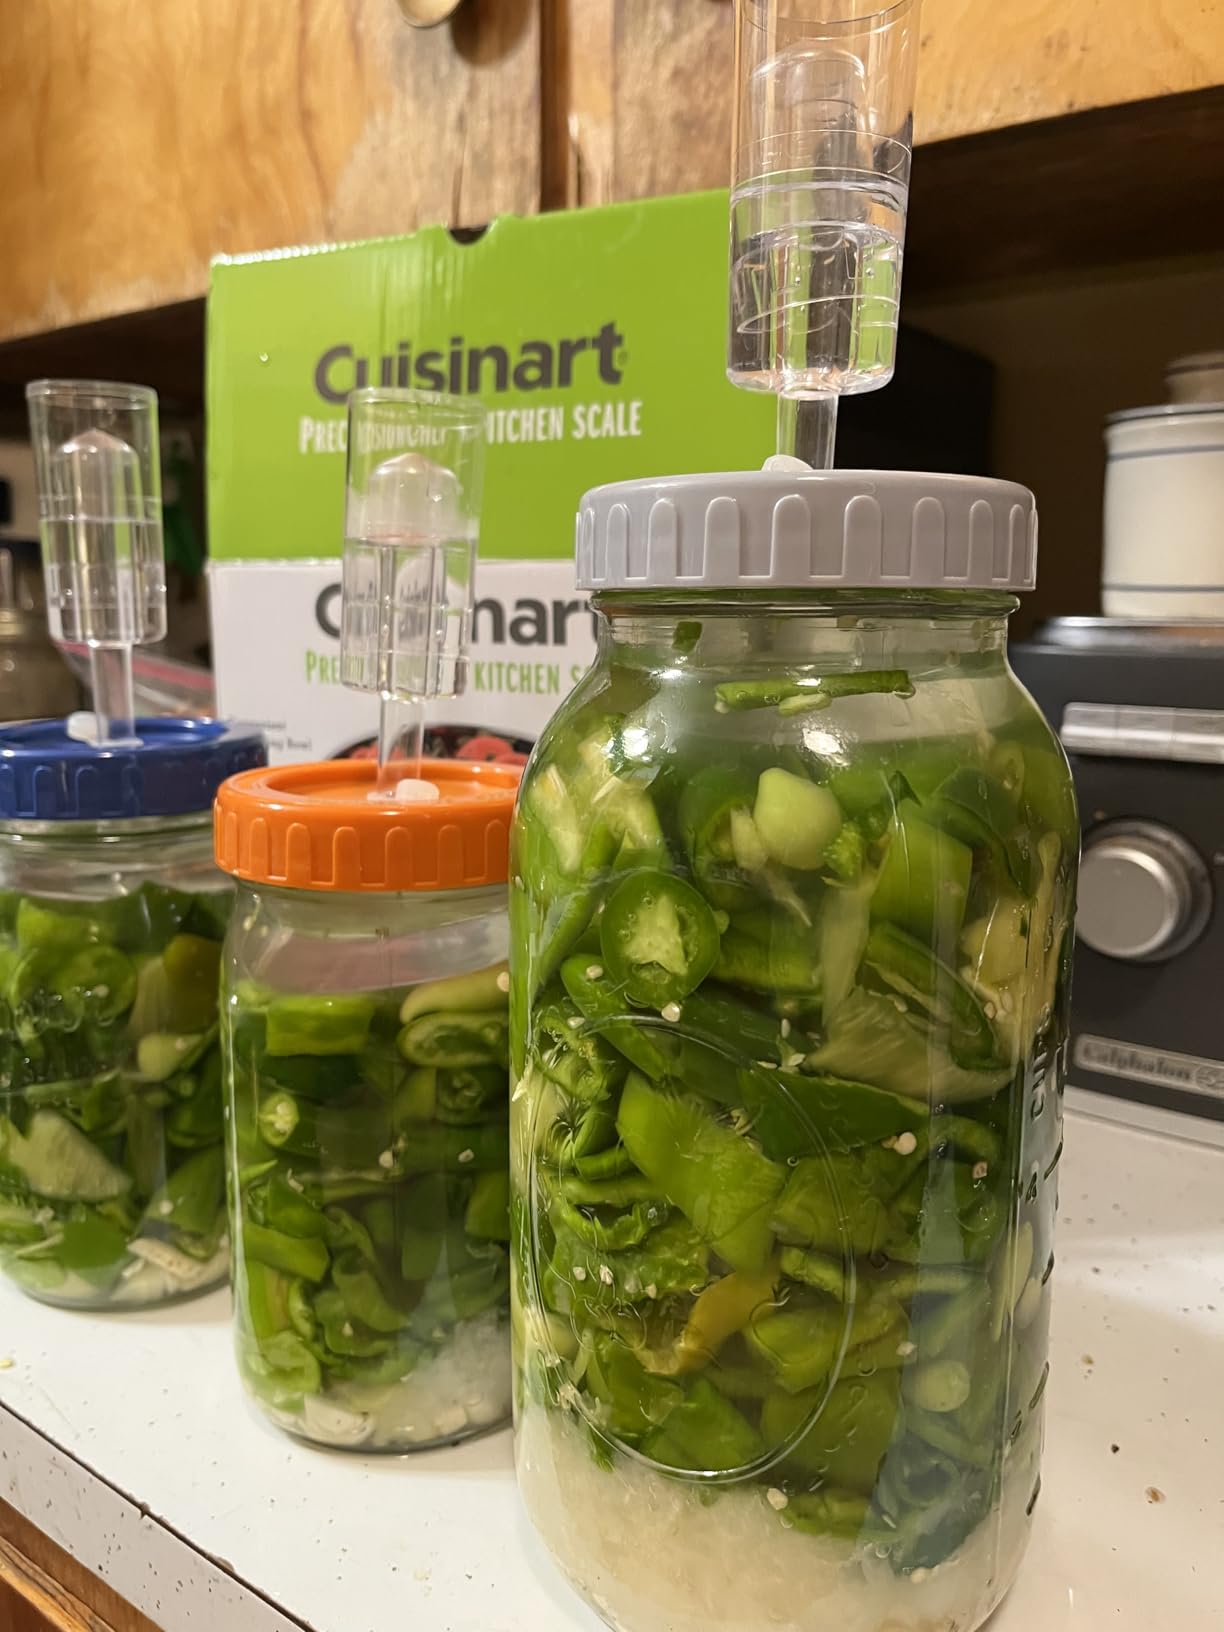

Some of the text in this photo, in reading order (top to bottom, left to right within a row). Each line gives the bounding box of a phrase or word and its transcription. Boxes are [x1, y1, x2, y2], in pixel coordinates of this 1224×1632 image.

[314, 321, 625, 406] Cuisinart
[572, 401, 643, 439] SCALE
[474, 661, 560, 695] KITCHEN
